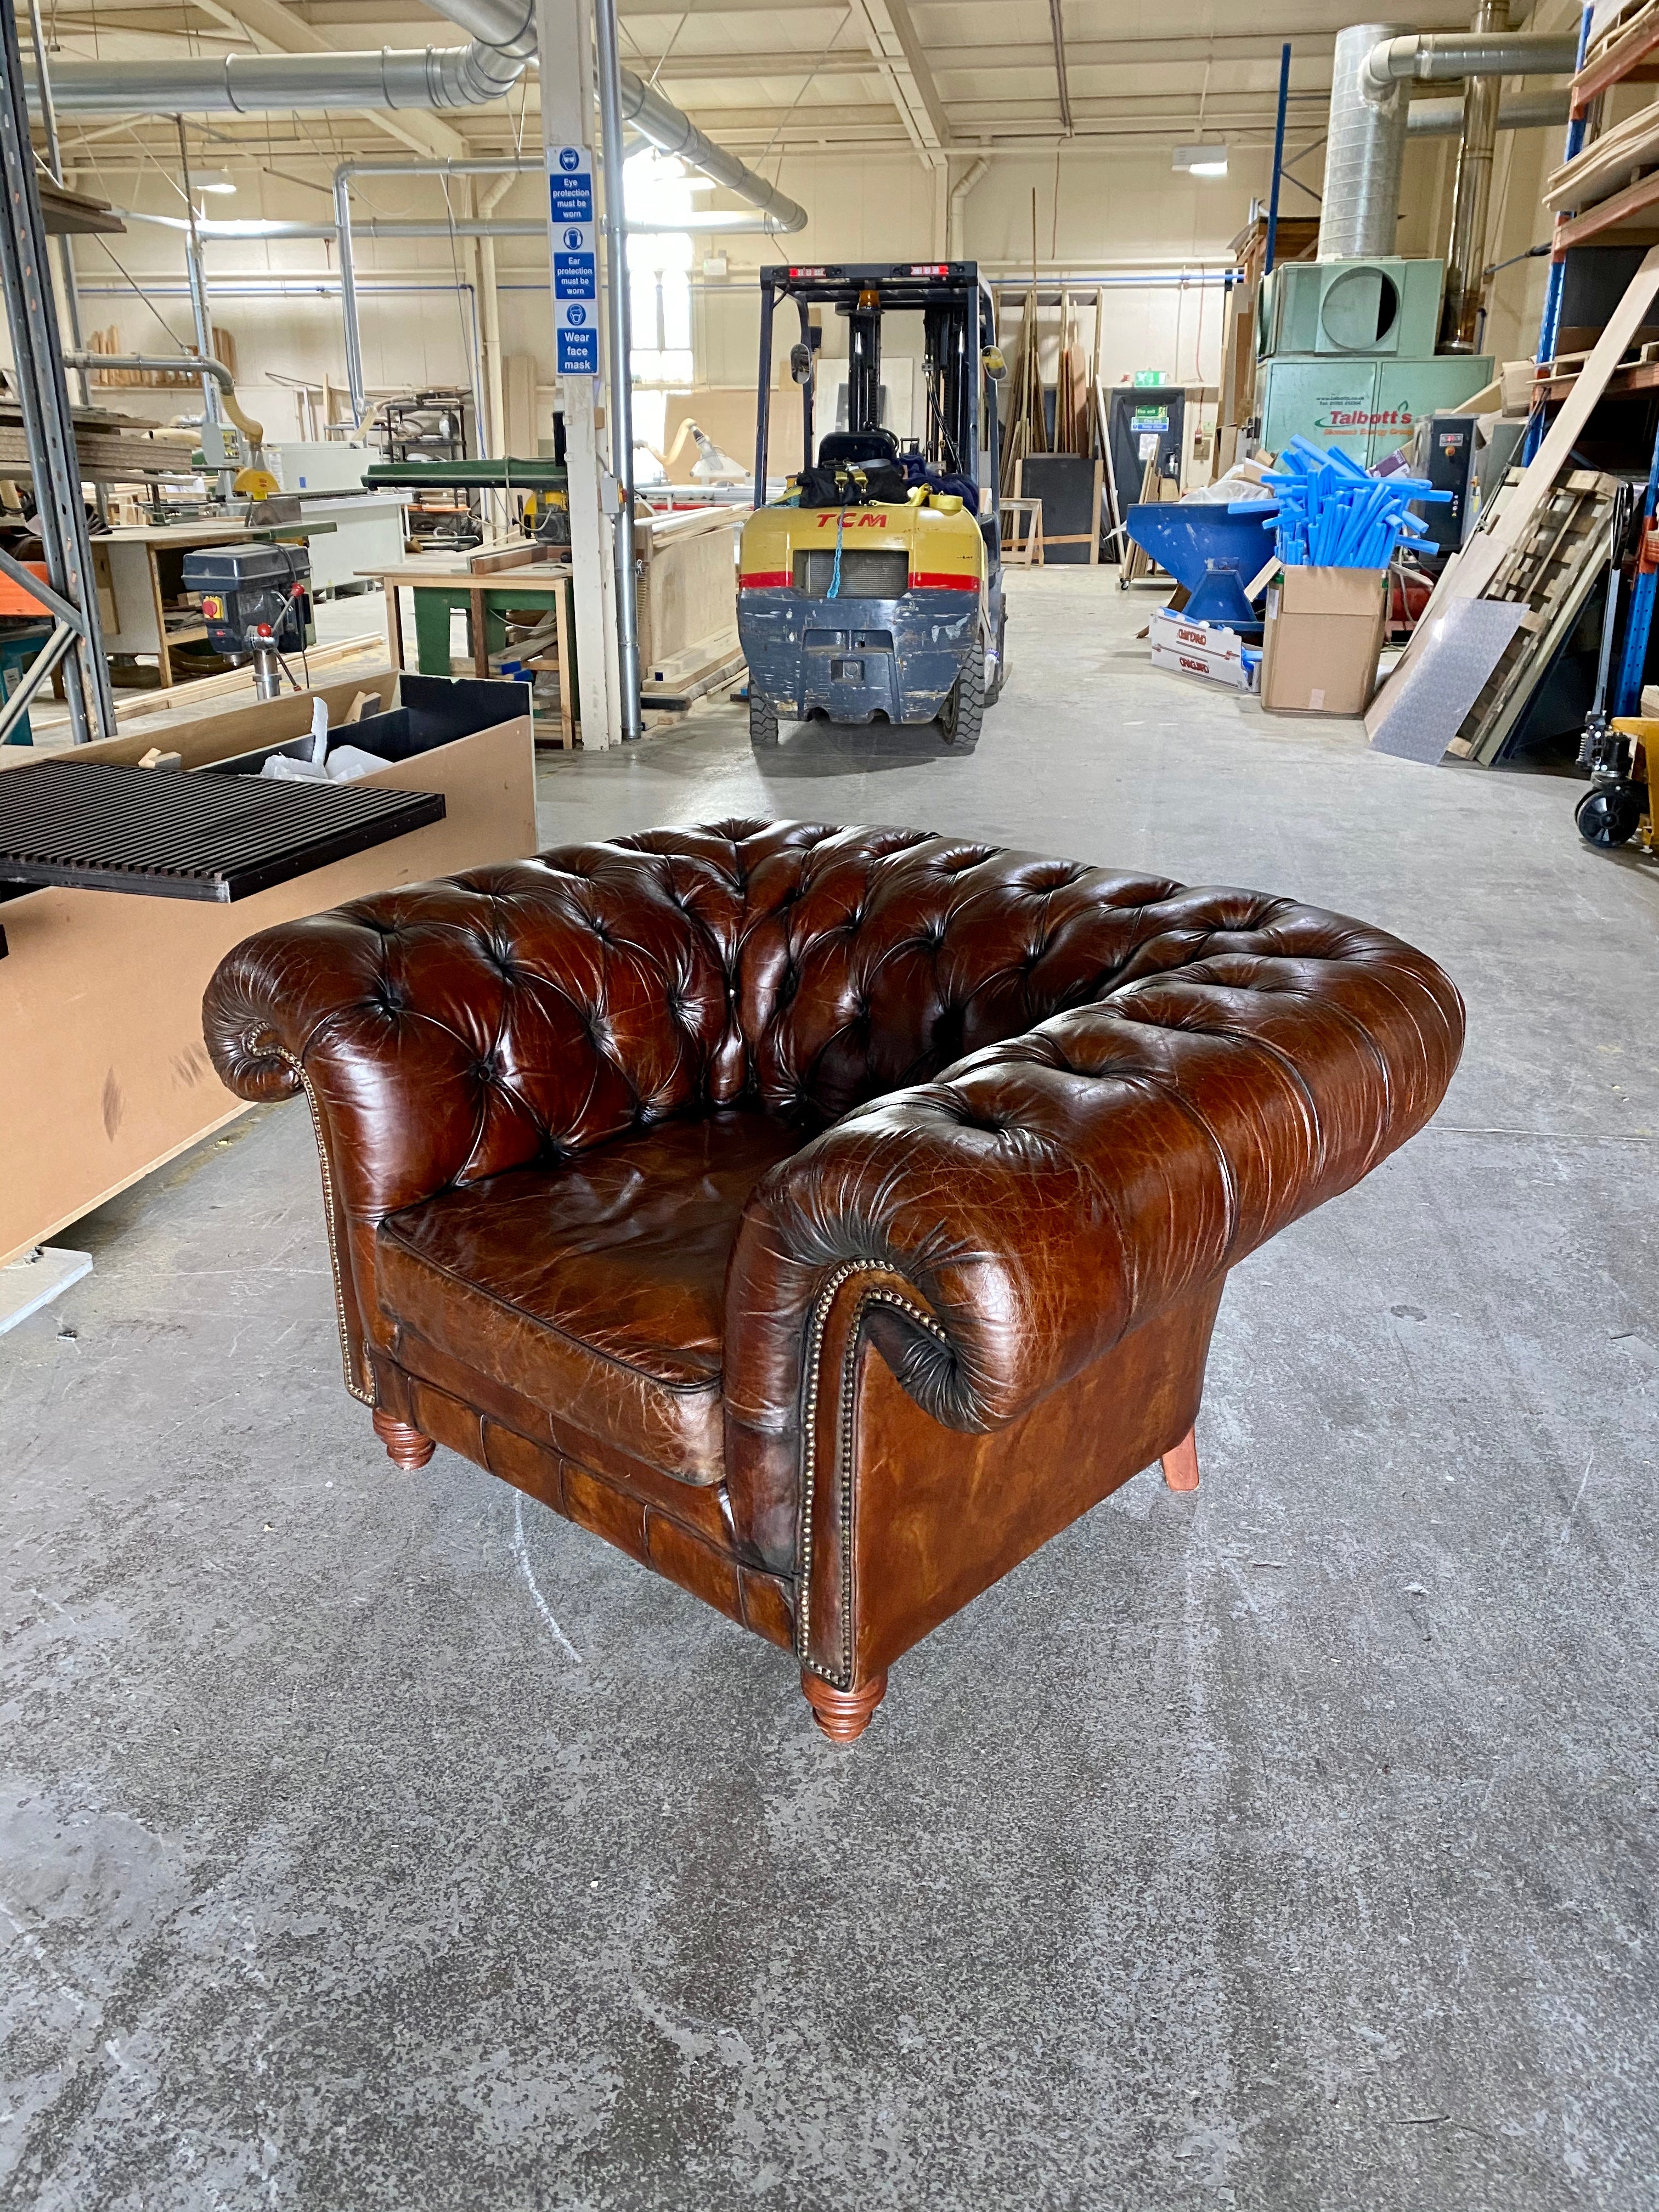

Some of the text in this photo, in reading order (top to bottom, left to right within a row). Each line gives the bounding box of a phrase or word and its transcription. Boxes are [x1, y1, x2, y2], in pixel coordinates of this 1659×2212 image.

[563, 178, 578, 187] Eye
[552, 188, 590, 199] protection
[577, 199, 586, 207] be
[557, 267, 592, 276] protection
[564, 332, 590, 342] Wear
[567, 346, 588, 356] face
[564, 359, 591, 369] mask
[817, 512, 887, 528] TCM
